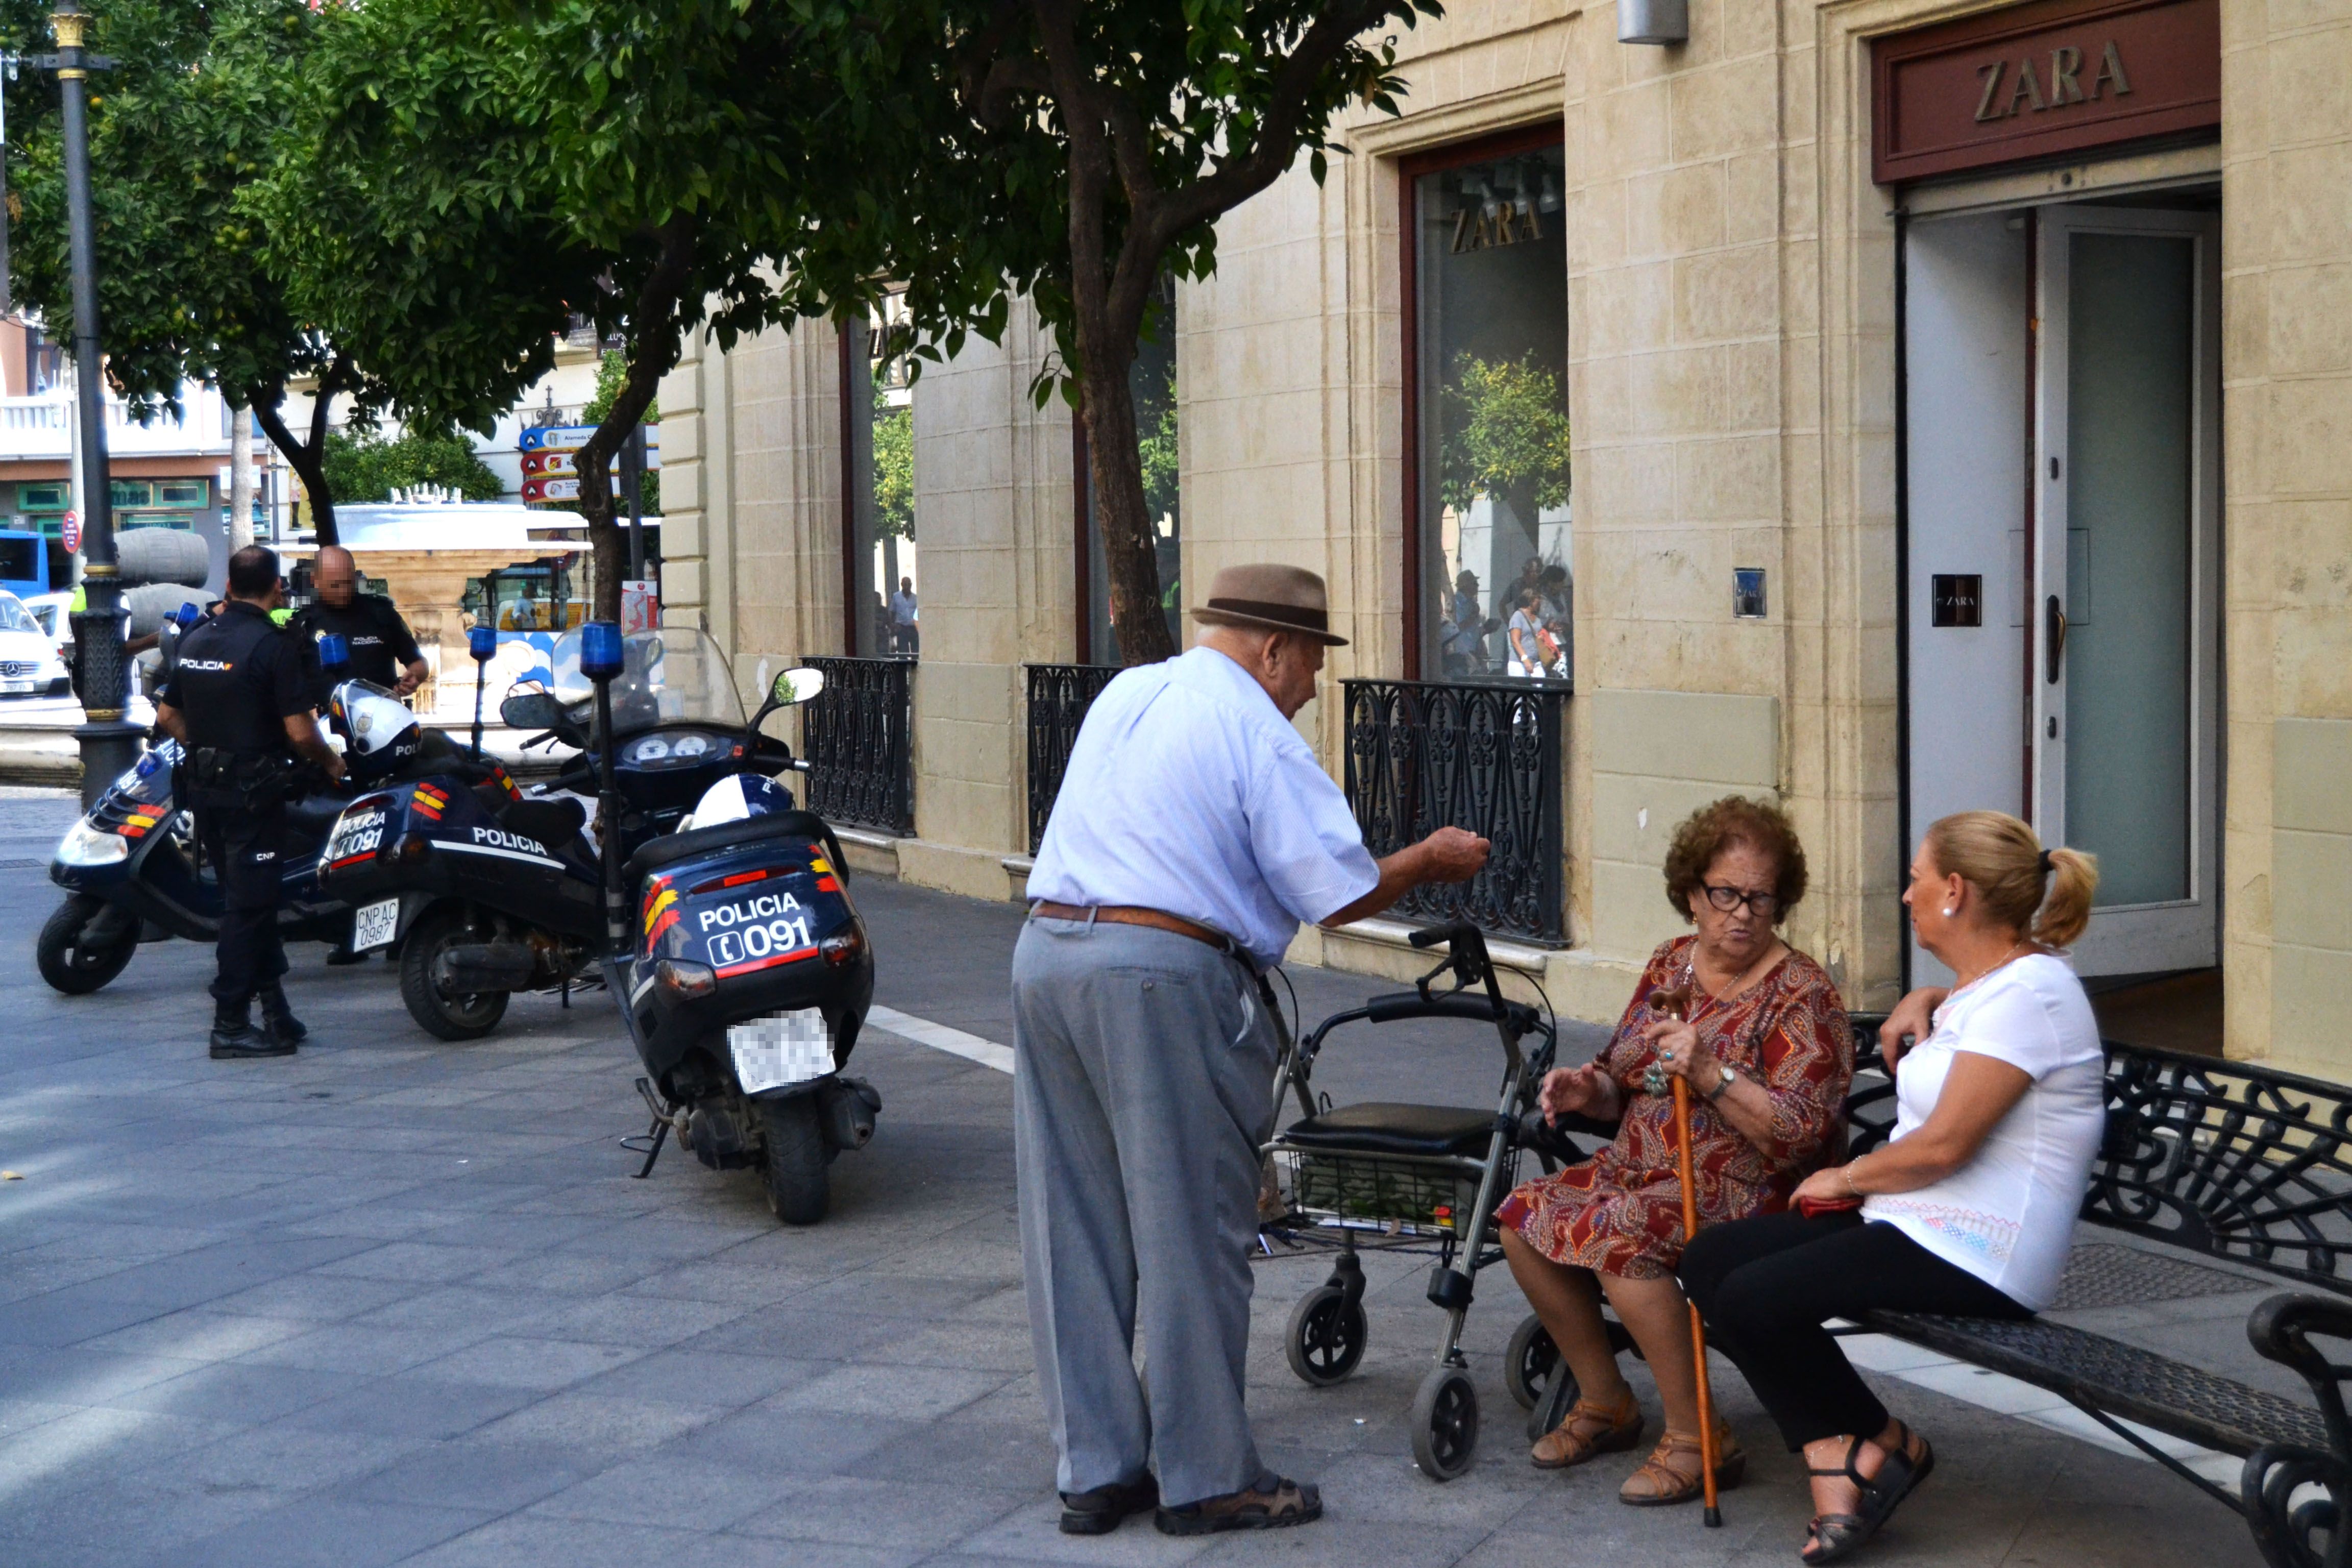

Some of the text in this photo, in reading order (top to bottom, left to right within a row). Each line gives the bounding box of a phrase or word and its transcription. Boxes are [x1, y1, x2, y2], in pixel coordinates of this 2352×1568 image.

[1975, 38, 2134, 122] ZARA
[1450, 200, 1544, 254] ZARA
[1946, 596, 1974, 606] ZARA
[180, 658, 225, 671] POLICIA
[341, 811, 385, 836] POLICIA
[350, 828, 383, 853] 091
[473, 827, 548, 855] POLICIA
[257, 852, 275, 861] CNP
[358, 902, 396, 929] CNP AC
[699, 892, 800, 932] POLICIA
[361, 921, 391, 946] 0987
[744, 916, 811, 957] 091
